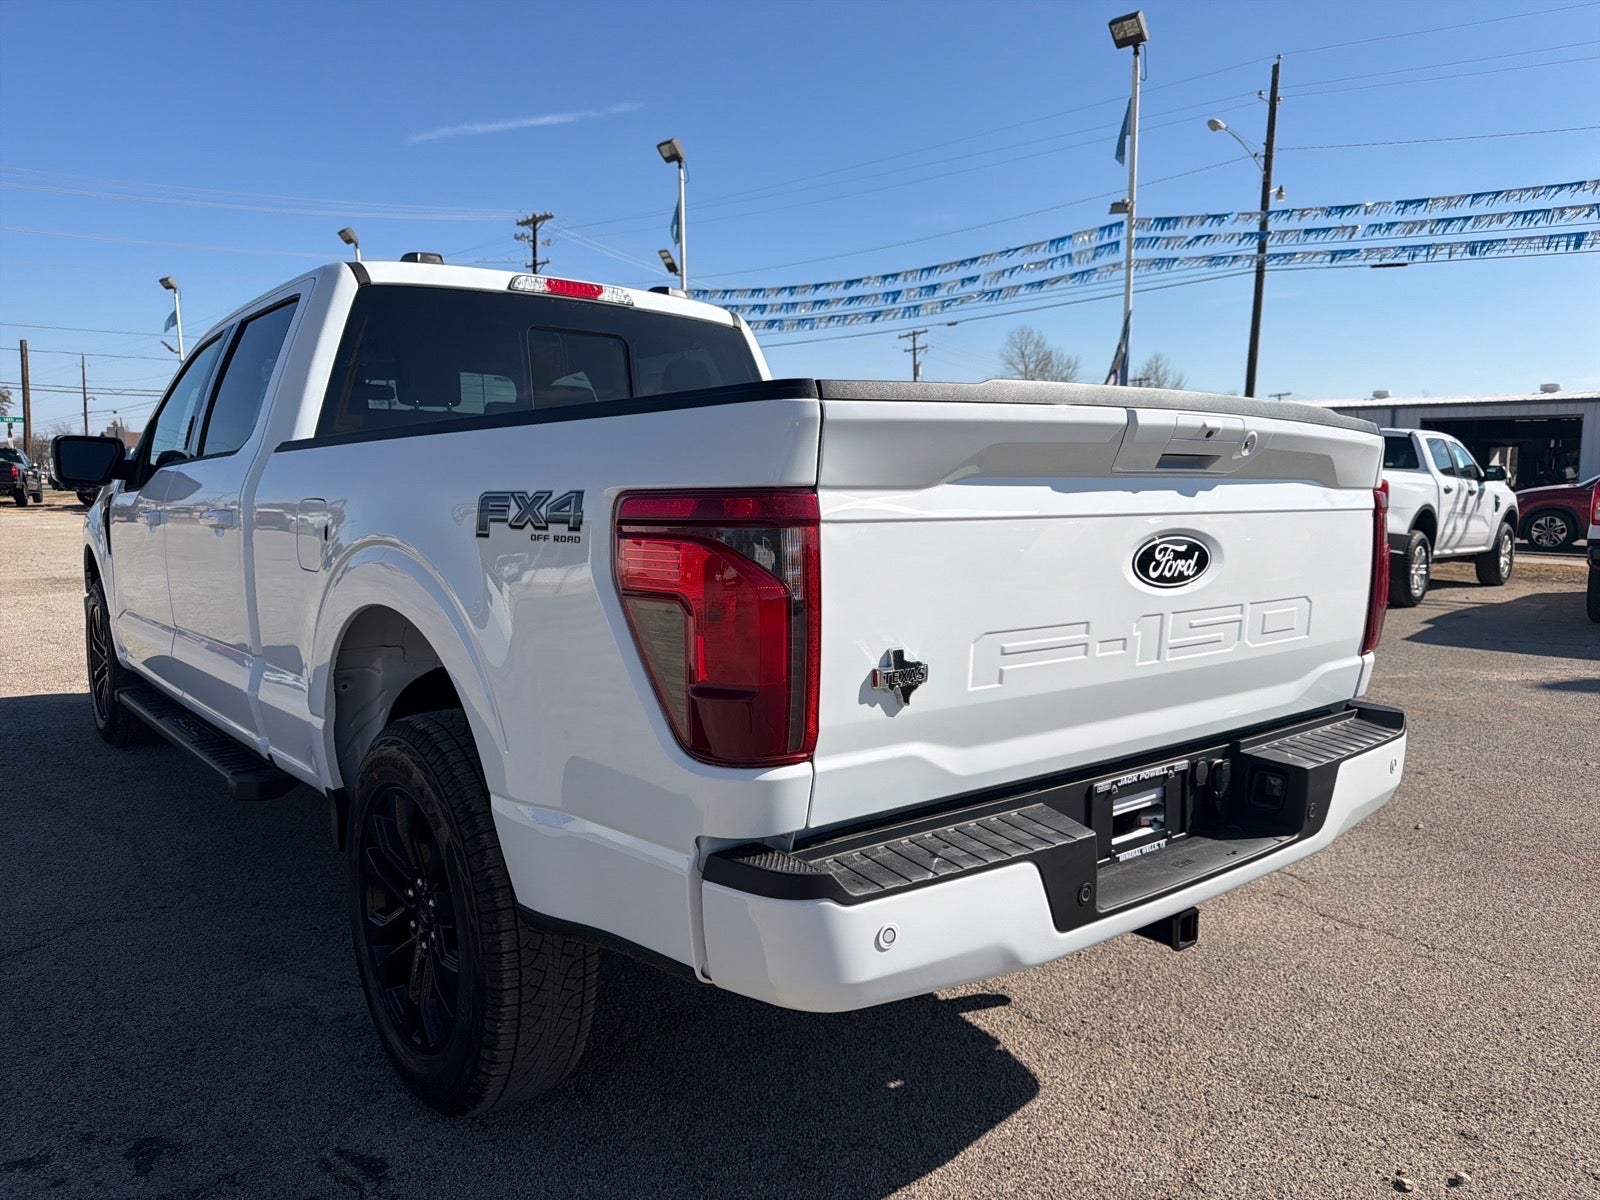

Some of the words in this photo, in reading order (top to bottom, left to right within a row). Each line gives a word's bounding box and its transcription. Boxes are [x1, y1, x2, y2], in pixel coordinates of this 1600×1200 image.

[476, 490, 585, 538] FX4
[530, 534, 550, 542] OFF
[553, 535, 581, 544] ROAD
[1149, 543, 1200, 579] Ford
[968, 595, 1313, 691] F-150
[882, 667, 925, 686] TEXAS
[1117, 774, 1139, 787] JACK
[1139, 766, 1169, 781] POWELL
